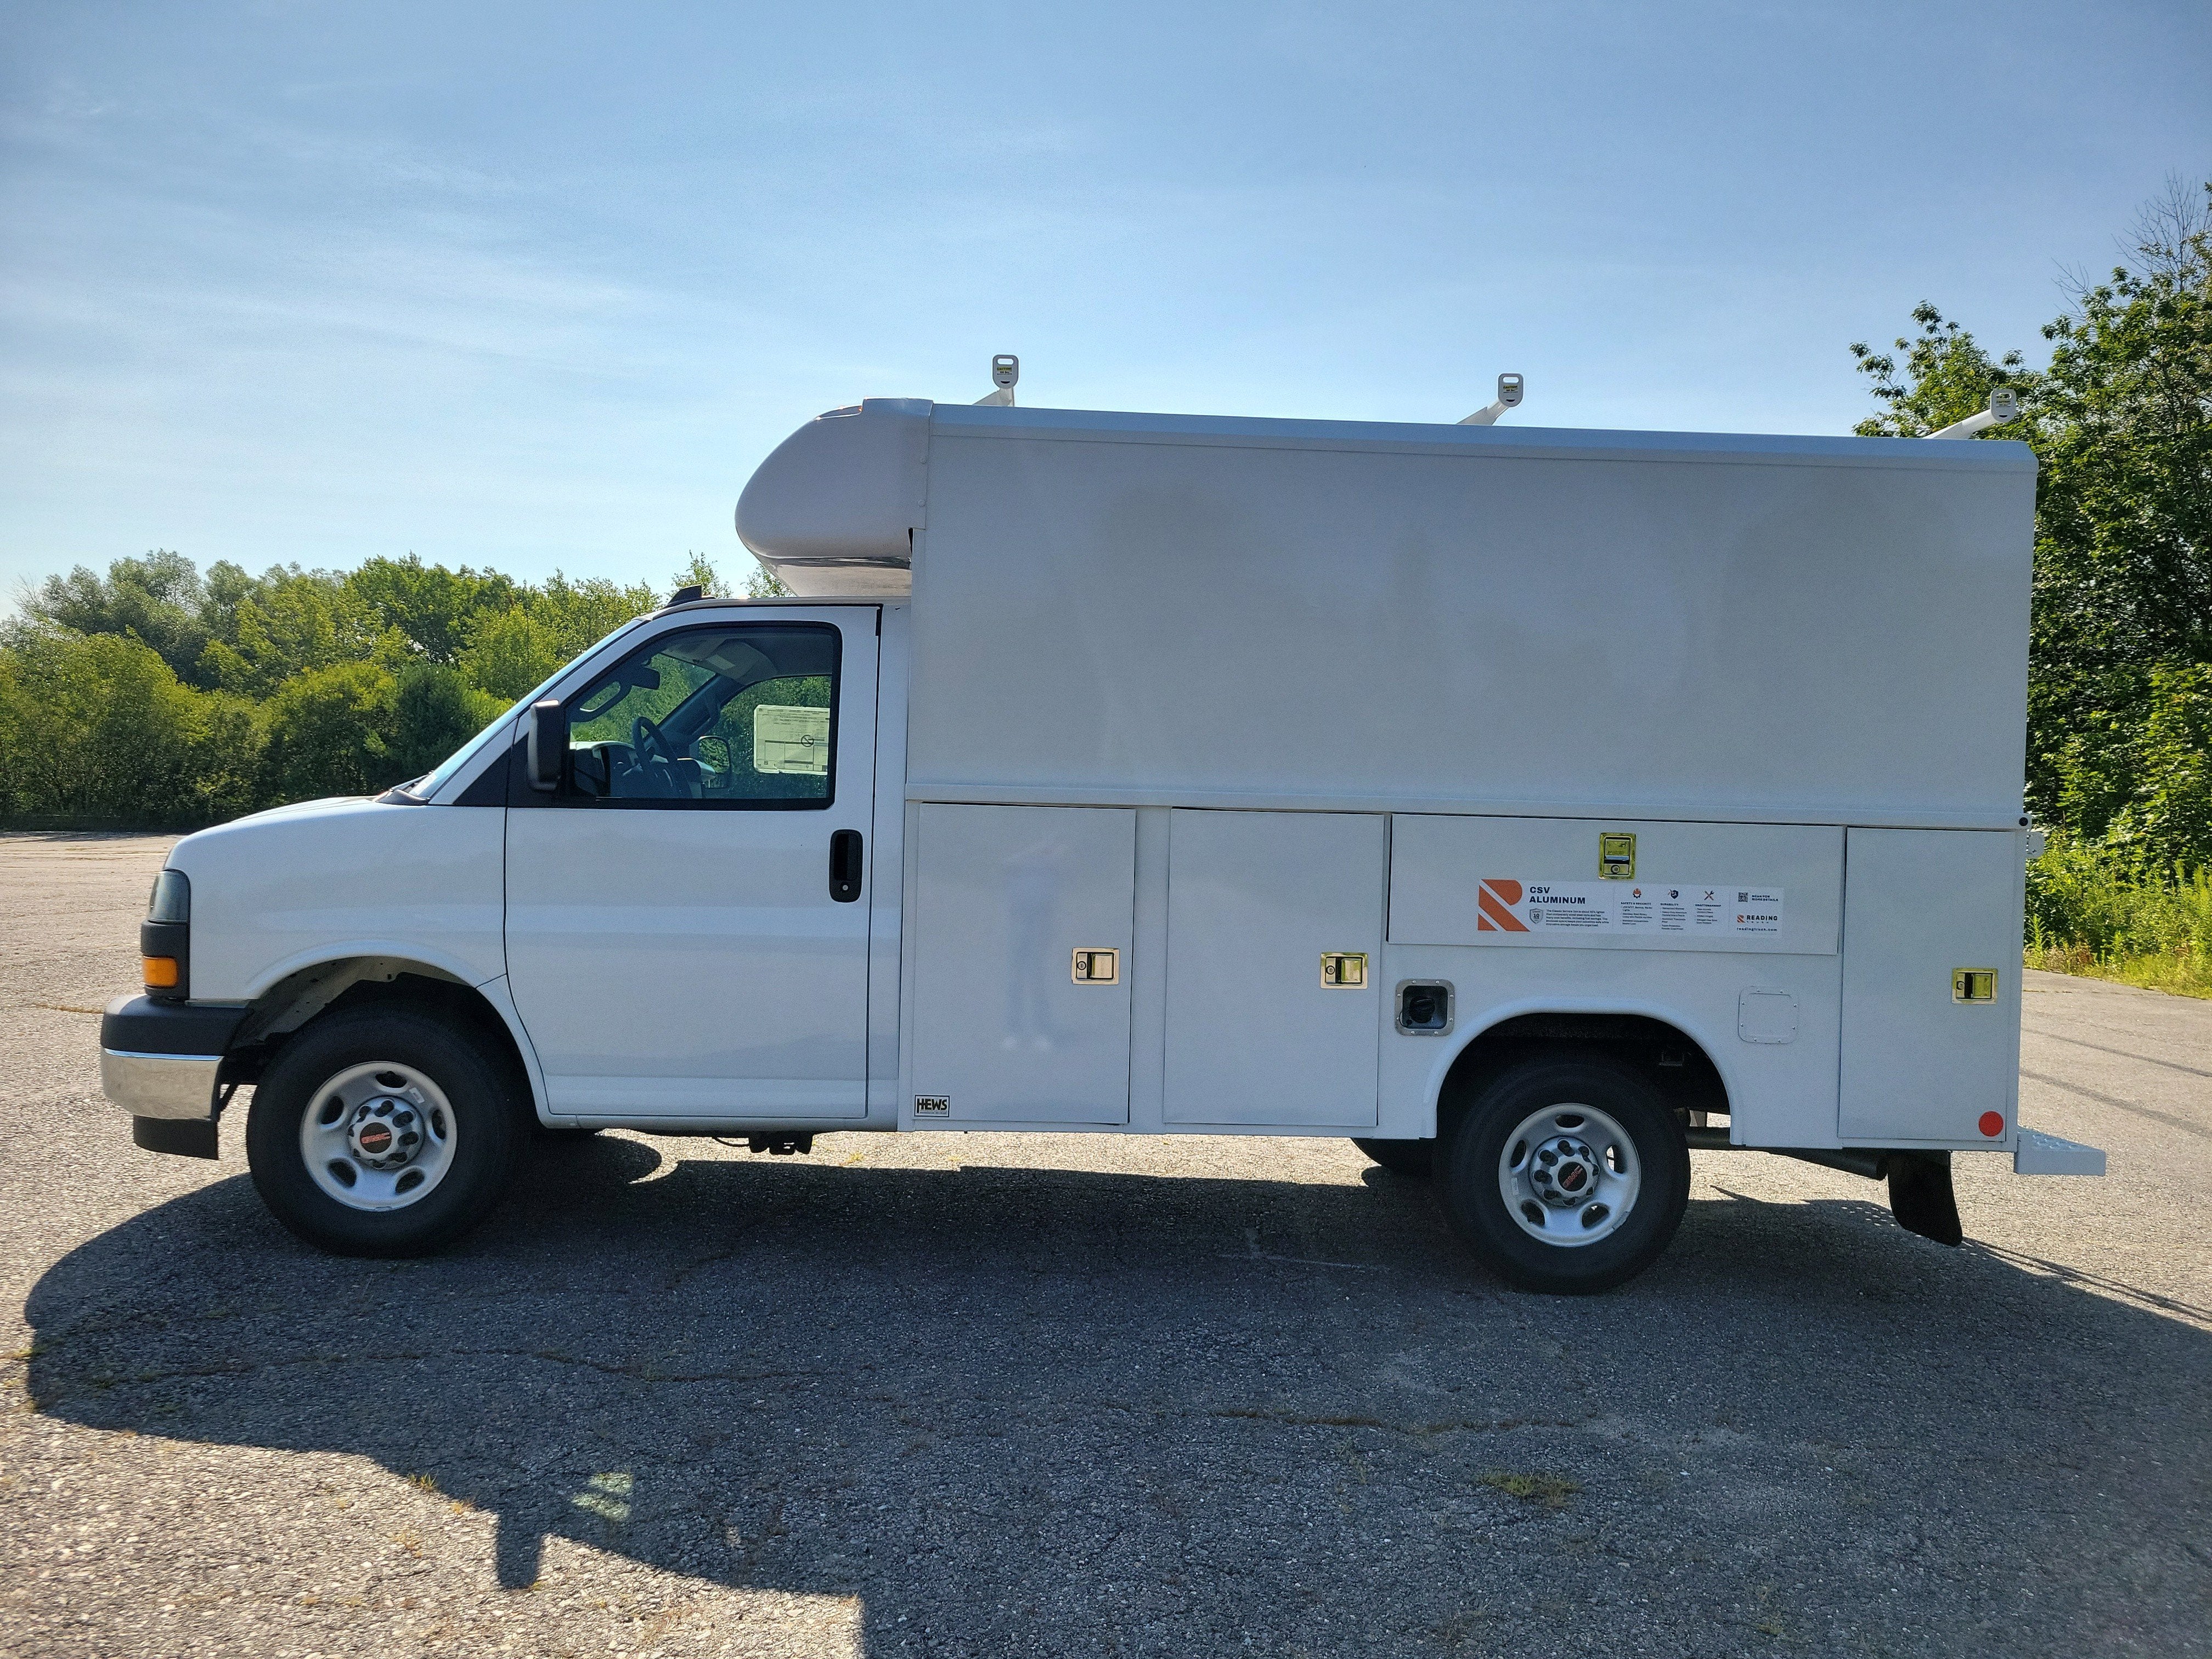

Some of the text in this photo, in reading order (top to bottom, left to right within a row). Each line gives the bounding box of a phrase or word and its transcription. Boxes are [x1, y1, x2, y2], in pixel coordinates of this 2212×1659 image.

[1529, 896, 1585, 904] ALUMINUM
[917, 1098, 947, 1113] HEWS
[1562, 1165, 1583, 1188] GMC
